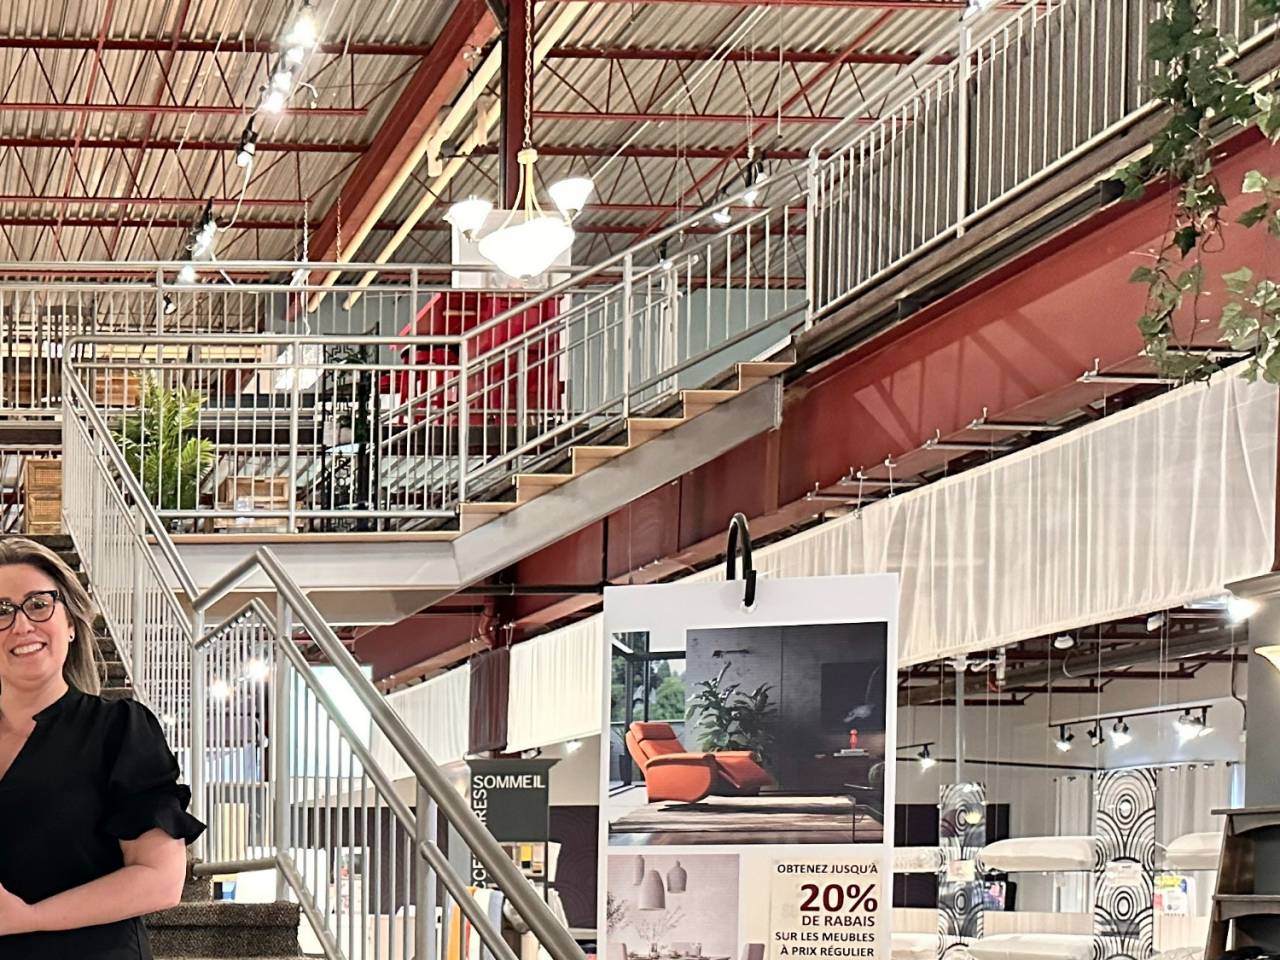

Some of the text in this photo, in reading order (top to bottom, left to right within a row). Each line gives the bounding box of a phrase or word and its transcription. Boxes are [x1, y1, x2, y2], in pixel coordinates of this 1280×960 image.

[473, 775, 545, 789] SOMMEIL
[777, 863, 878, 875] OBTENEZ JUSQU'À
[800, 884, 878, 912] 20%
[802, 915, 875, 927] DE RABAIS
[775, 932, 875, 942] SUR LES MEUBLES
[780, 944, 874, 957] À PRIX RÉGULIER
